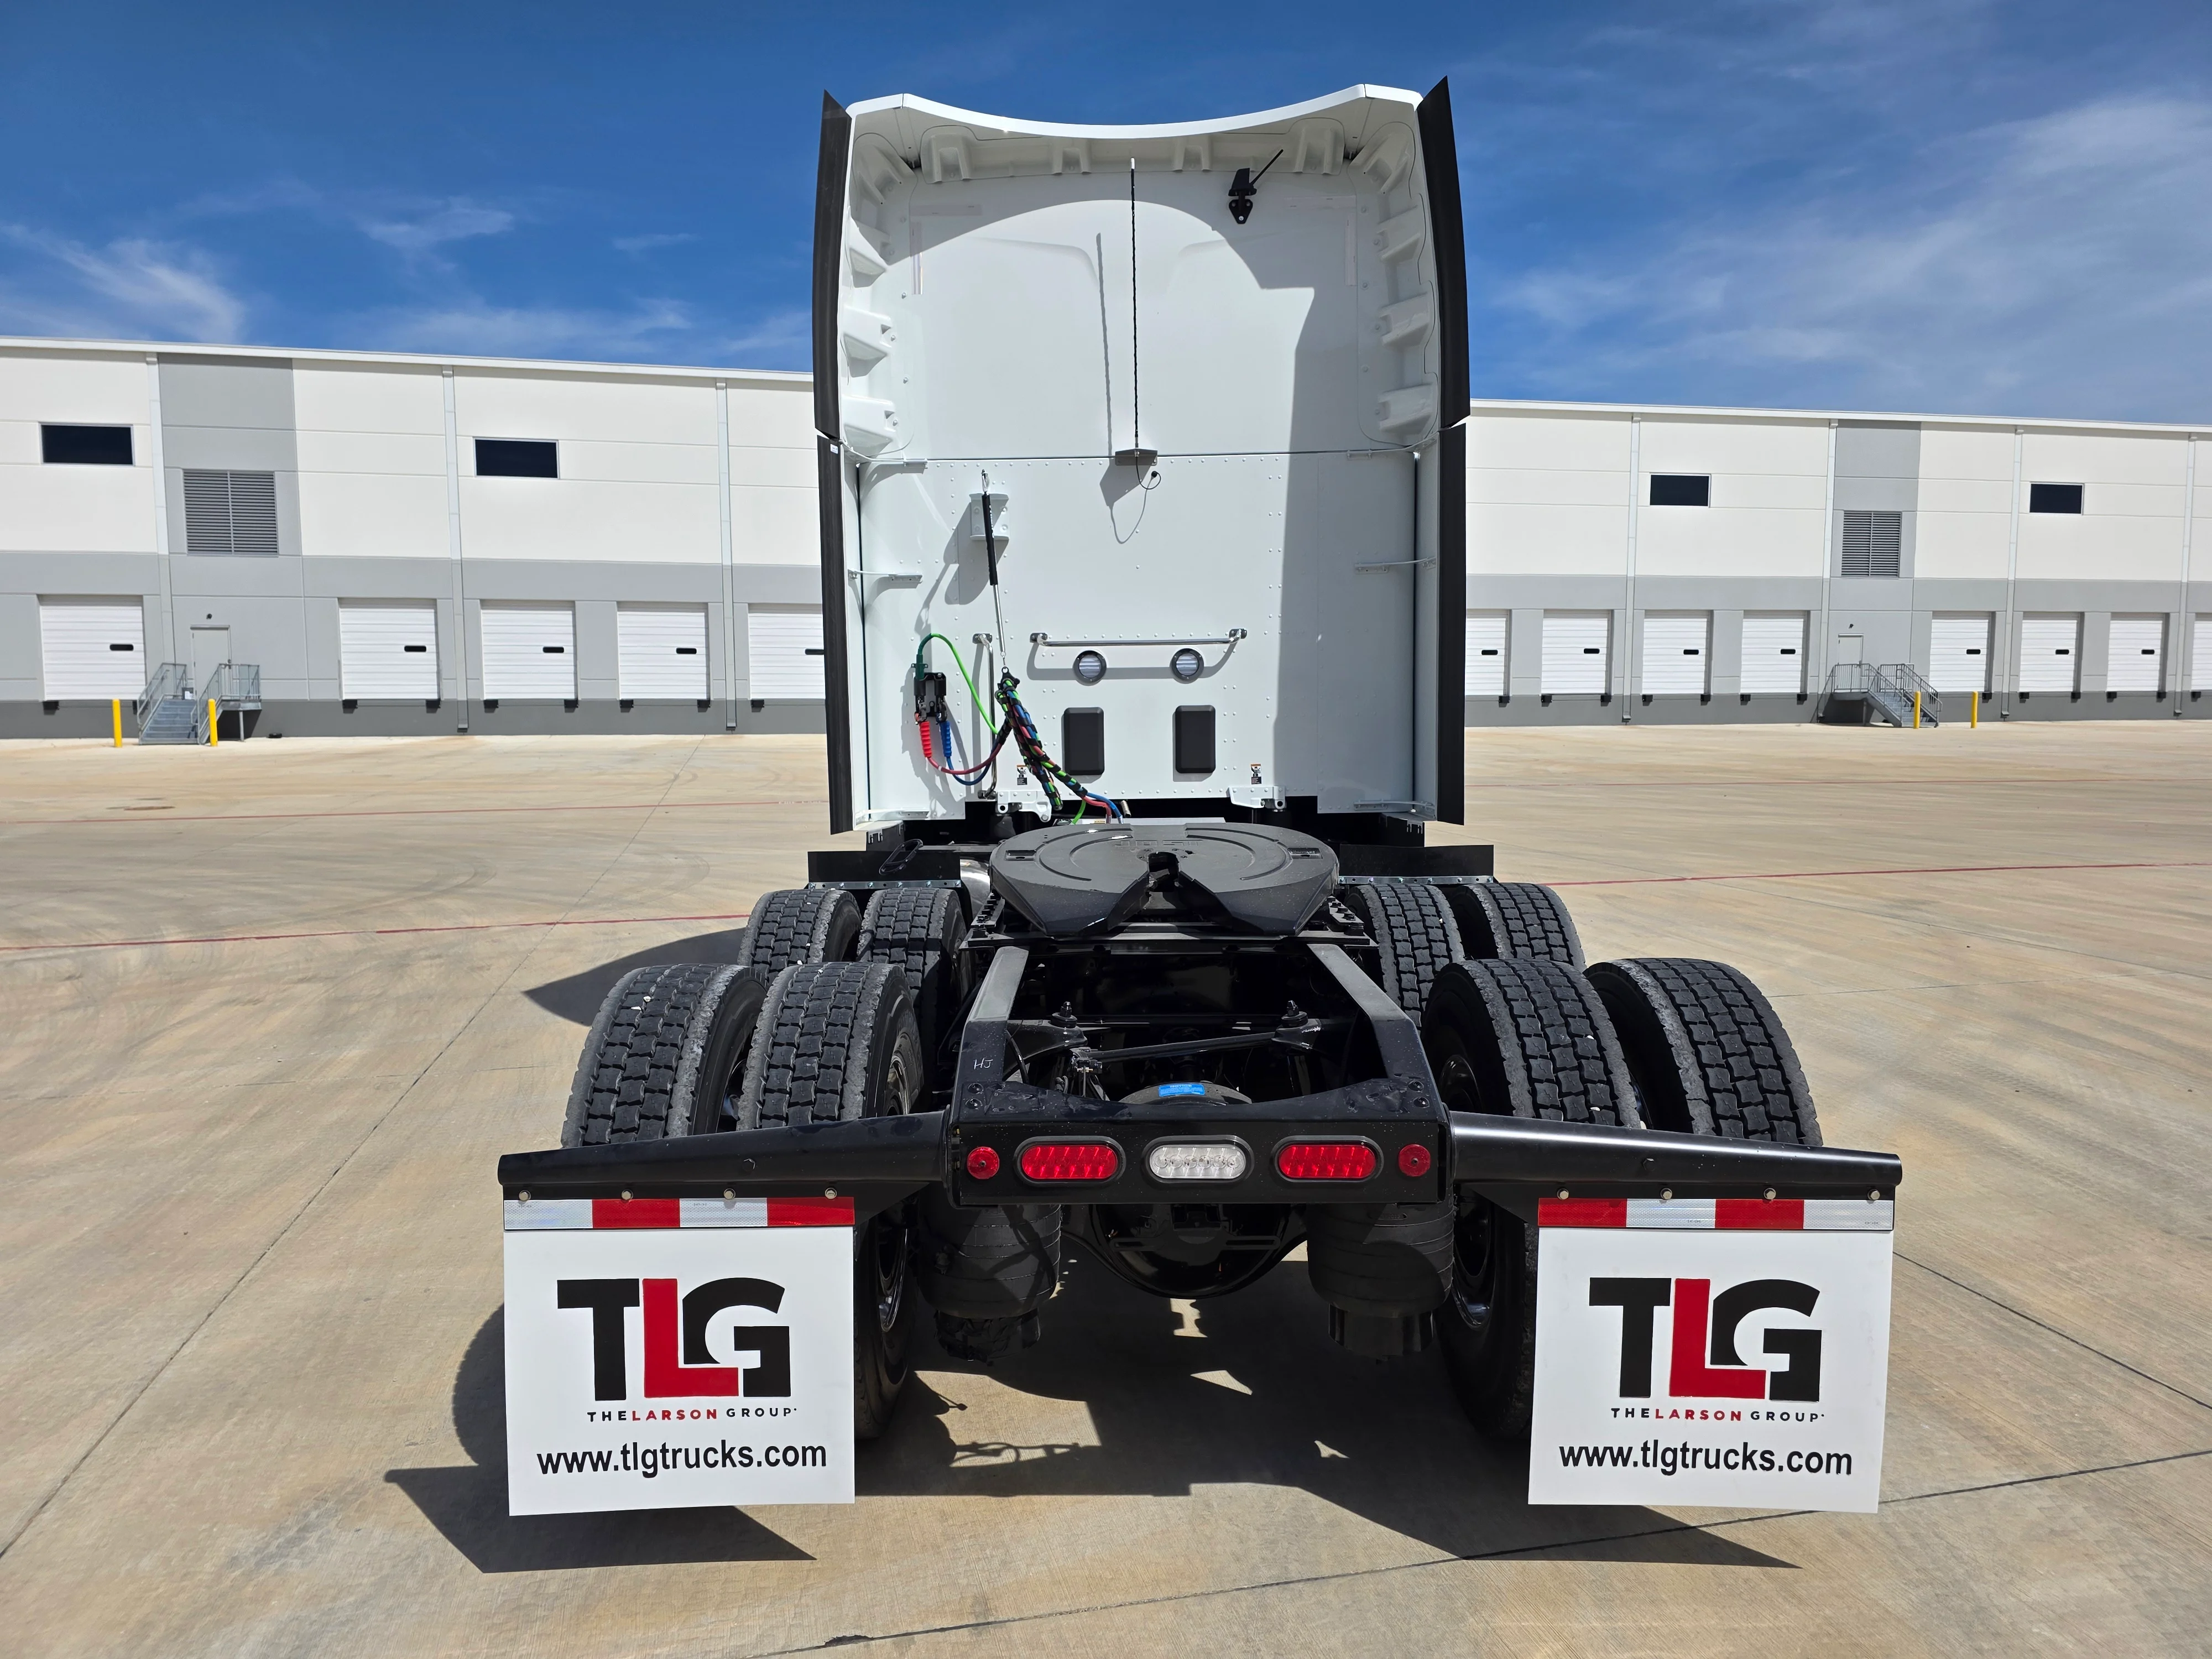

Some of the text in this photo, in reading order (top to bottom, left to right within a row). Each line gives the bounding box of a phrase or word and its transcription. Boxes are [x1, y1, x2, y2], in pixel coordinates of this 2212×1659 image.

[556, 1277, 791, 1401] TLG
[1589, 1277, 1822, 1402] TLG
[726, 1407, 791, 1417] GROUP
[1750, 1411, 1819, 1422] GROUP
[536, 1439, 827, 1479] www.tlgtrucks.com
[1559, 1439, 1853, 1477] www.tlgtrucks.com
